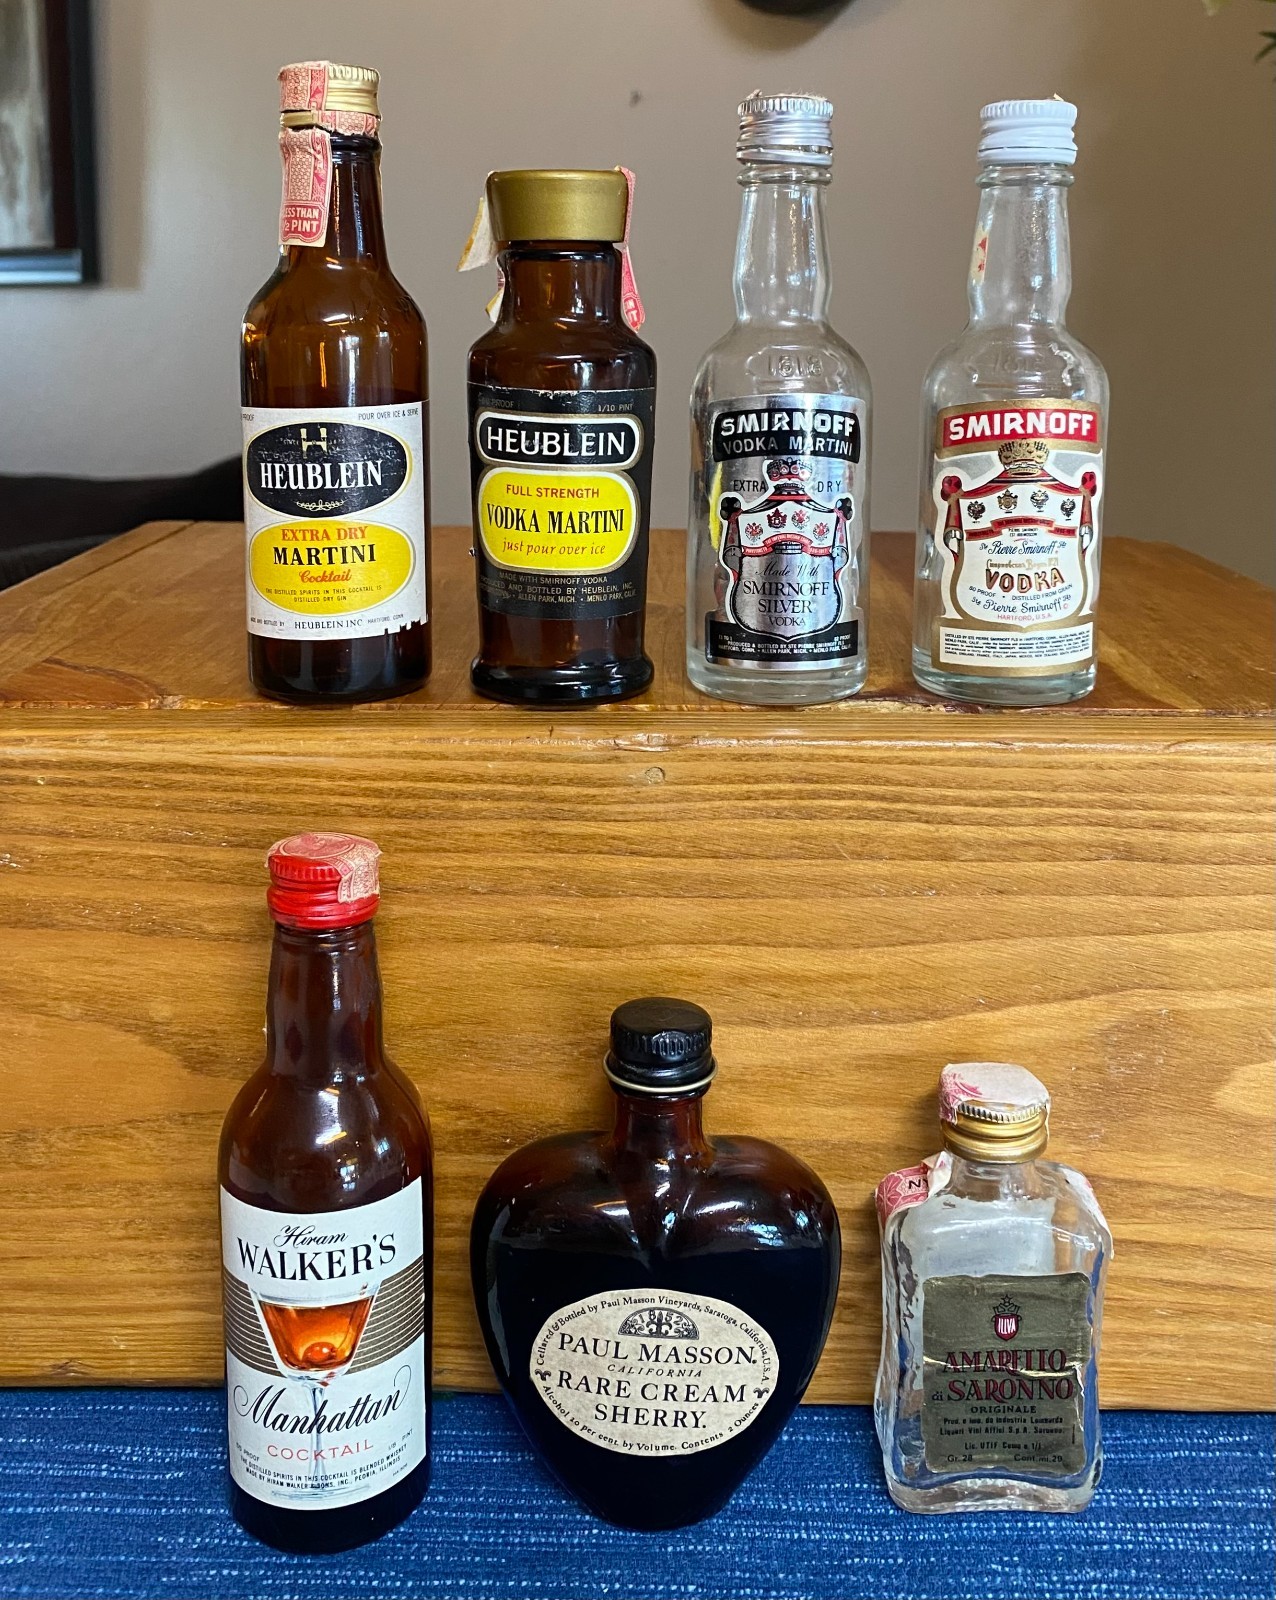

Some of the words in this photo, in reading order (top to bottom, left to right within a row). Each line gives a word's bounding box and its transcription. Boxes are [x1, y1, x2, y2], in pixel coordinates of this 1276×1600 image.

[296, 207, 319, 219] THAN
[291, 219, 320, 233] PINT
[376, 412, 390, 420] OVER
[407, 407, 419, 417] SERVE
[720, 411, 855, 437] SMIRNOFF
[949, 411, 1094, 441] SMIRNOFF
[486, 426, 626, 457] HEUBLEIN
[722, 436, 778, 456] VODKA
[788, 435, 853, 457] MARTINI
[260, 459, 383, 490] HEUBLEIN
[505, 484, 533, 497] FULL
[536, 487, 600, 500] STRENGTH
[733, 479, 768, 492] EXTRA
[817, 479, 842, 493] DRY
[486, 502, 541, 534] VODKA
[547, 508, 625, 535] MARTINI
[281, 527, 330, 542] EXTRA
[336, 525, 369, 542] DRY
[273, 543, 377, 566] MARTINI
[502, 537, 525, 554] just
[526, 542, 557, 556] pour
[559, 545, 586, 555] over
[590, 542, 606, 555] ice
[988, 540, 1018, 555] Pierre
[1018, 540, 1056, 555] Smirnoff
[299, 568, 353, 584] Cocktail
[500, 571, 517, 582] MADE
[520, 576, 538, 584] WITH
[540, 577, 580, 585] SMIRNOFF
[582, 576, 608, 584] VODKA
[755, 561, 790, 577] Made
[507, 583, 523, 592] AND
[527, 586, 562, 594] BOTTLED
[743, 580, 830, 597] SMIRNOFF
[985, 567, 1065, 594] VODKA
[518, 594, 536, 602] ALLEN
[538, 596, 558, 604] PARK,
[586, 594, 607, 602] MENLO
[976, 589, 996, 598] PROOF
[1057, 583, 1073, 593] GRAIN
[757, 599, 813, 614] SILVER
[982, 599, 1018, 613] Pierre
[1021, 598, 1062, 614] Smirnoff
[294, 620, 344, 630] HEUBLEIN
[768, 615, 807, 627] VODKA
[273, 1224, 349, 1249] Hiram
[236, 1231, 396, 1282] WALKER'S
[536, 1328, 555, 1366] Cellared
[558, 1307, 587, 1327] Bottled
[587, 1304, 599, 1314] by
[600, 1298, 621, 1310] Paul
[622, 1296, 656, 1306] Masson
[658, 1295, 702, 1312] Vineyards,
[703, 1305, 738, 1327] Saratoga,
[998, 1317, 1016, 1335] ILLVA
[558, 1332, 629, 1360] PAUL
[637, 1343, 758, 1365] MASSON.
[607, 1363, 702, 1378] CALIFORNIA
[556, 1369, 632, 1399] RARE
[640, 1382, 747, 1403] CREAM
[932, 1391, 943, 1401] di
[947, 1377, 1075, 1404] SARONNO
[233, 1364, 412, 1435] Manhattan
[542, 1385, 570, 1417] Alcohol
[580, 1424, 597, 1437] per
[622, 1440, 634, 1451] by
[636, 1442, 677, 1452] Volume.
[681, 1431, 724, 1450] Contents
[733, 1402, 760, 1427] Ounces
[594, 1403, 707, 1429] SHERRY.
[970, 1406, 1036, 1414] ORIGINALE
[243, 1448, 260, 1462] PROOF
[267, 1439, 374, 1462] COCKTAIL
[240, 1455, 248, 1466] THE
[248, 1462, 272, 1476] DISTILLED
[273, 1471, 294, 1481] SPIRITS
[320, 1471, 349, 1482] COCKTAIL
[359, 1457, 385, 1474] BLENDED
[386, 1443, 408, 1461] WHISKEY
[245, 1467, 258, 1479] MADE
[266, 1477, 284, 1487] HIRAM
[354, 1470, 378, 1482] PEORIA,
[379, 1456, 401, 1472] ILLINOIS
